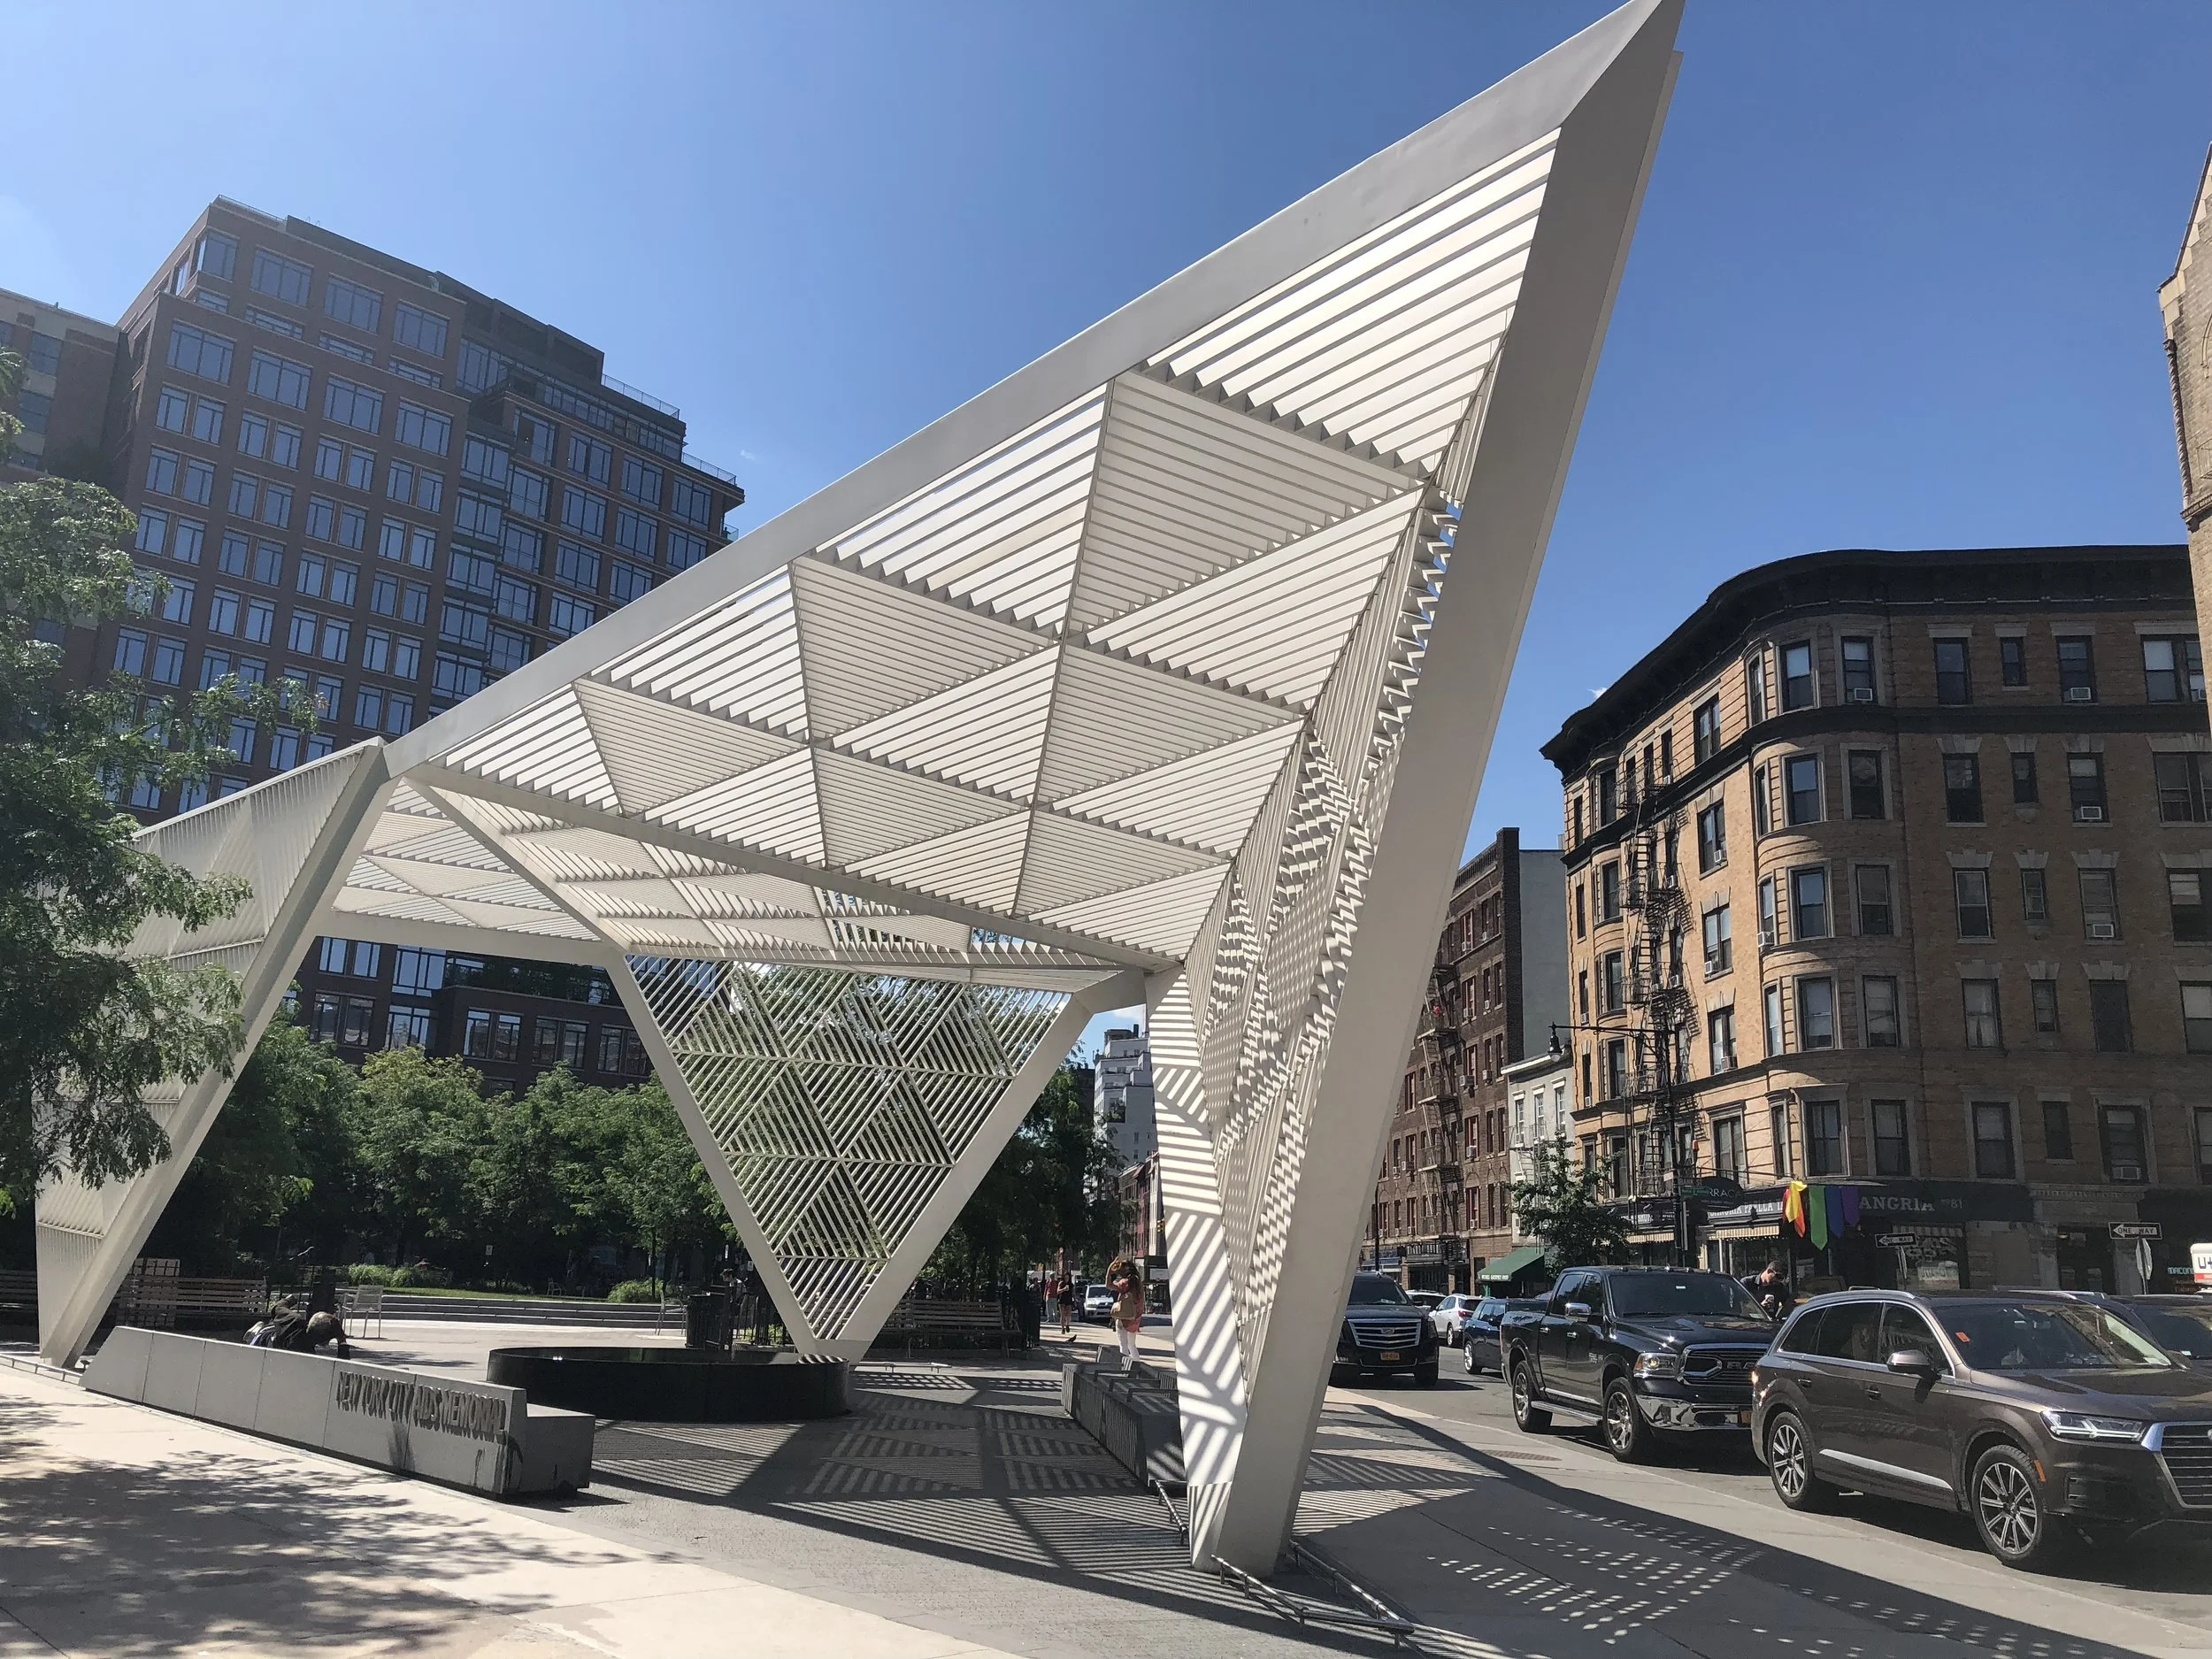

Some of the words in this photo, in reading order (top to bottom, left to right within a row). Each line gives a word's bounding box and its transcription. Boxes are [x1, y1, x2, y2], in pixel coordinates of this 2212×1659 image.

[1859, 1196, 1935, 1211] ANGRIA
[336, 1371, 362, 1409] NEW
[361, 1375, 388, 1416] YORK
[388, 1380, 414, 1421] CITY
[411, 1385, 442, 1427] AIDS
[441, 1389, 507, 1438] MEMORIAL
